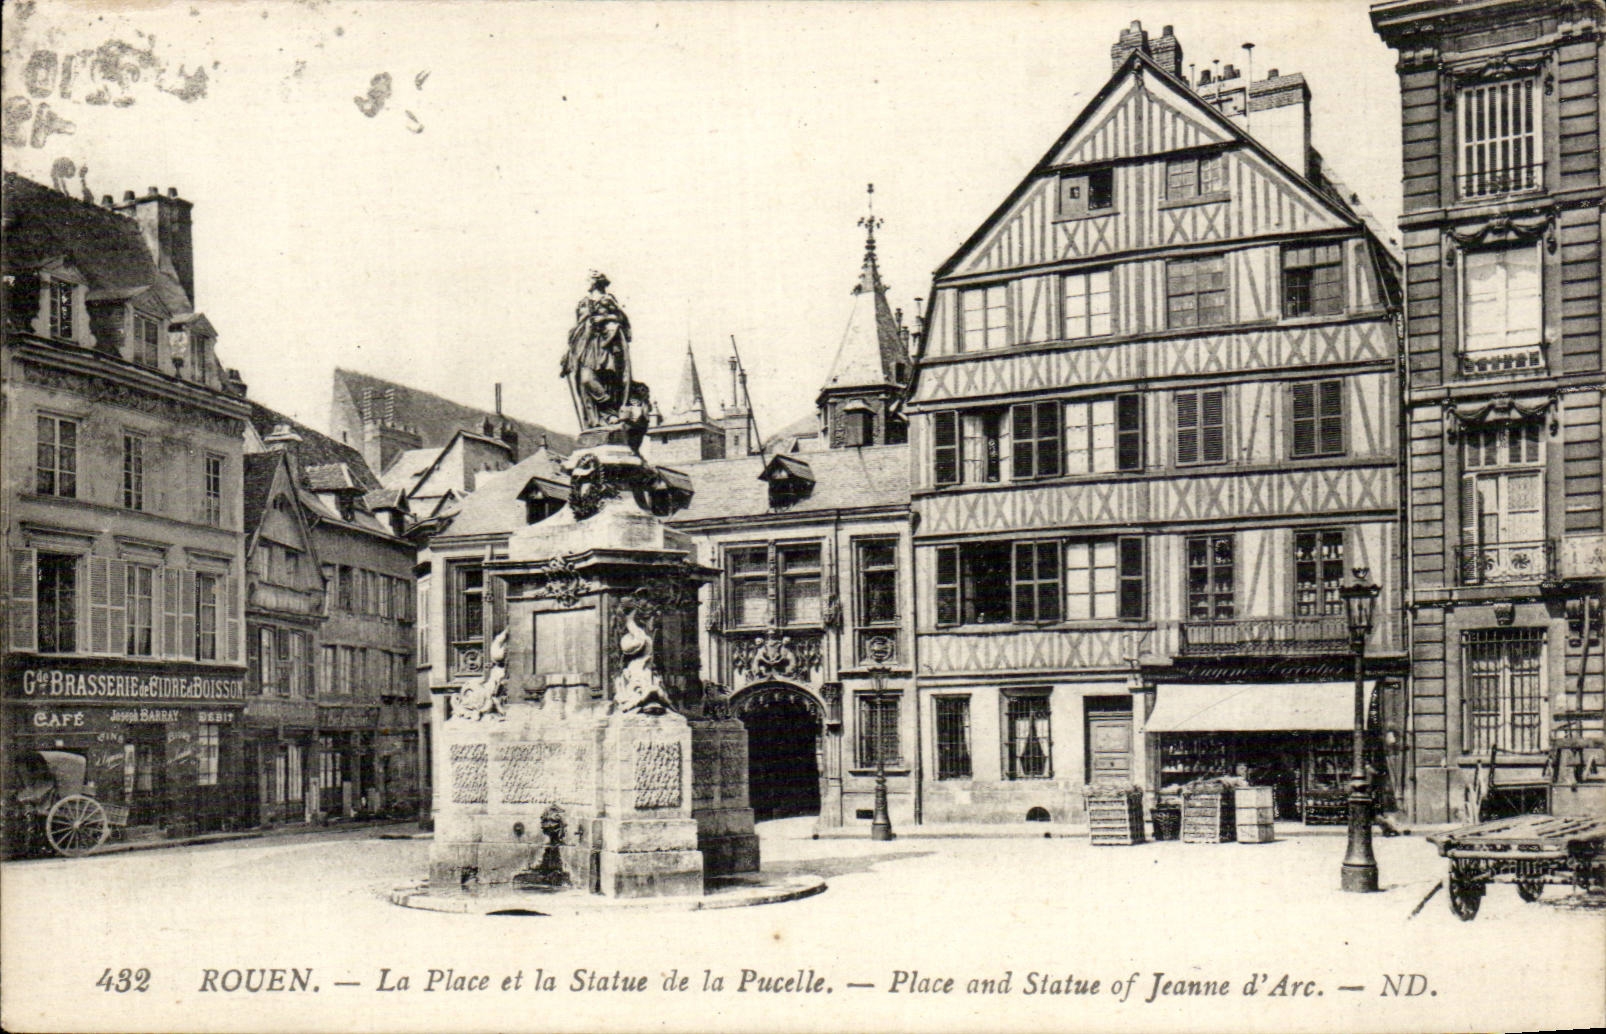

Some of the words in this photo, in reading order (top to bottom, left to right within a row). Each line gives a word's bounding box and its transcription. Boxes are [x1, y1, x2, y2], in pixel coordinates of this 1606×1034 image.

[50, 670, 139, 697] BRASSERIE
[139, 680, 149, 697] de
[149, 675, 187, 698] CIDRE
[193, 676, 243, 699] BOISSON
[33, 711, 85, 727] CAFÉ
[110, 709, 138, 723] Joseph
[140, 708, 180, 722] BARRAY
